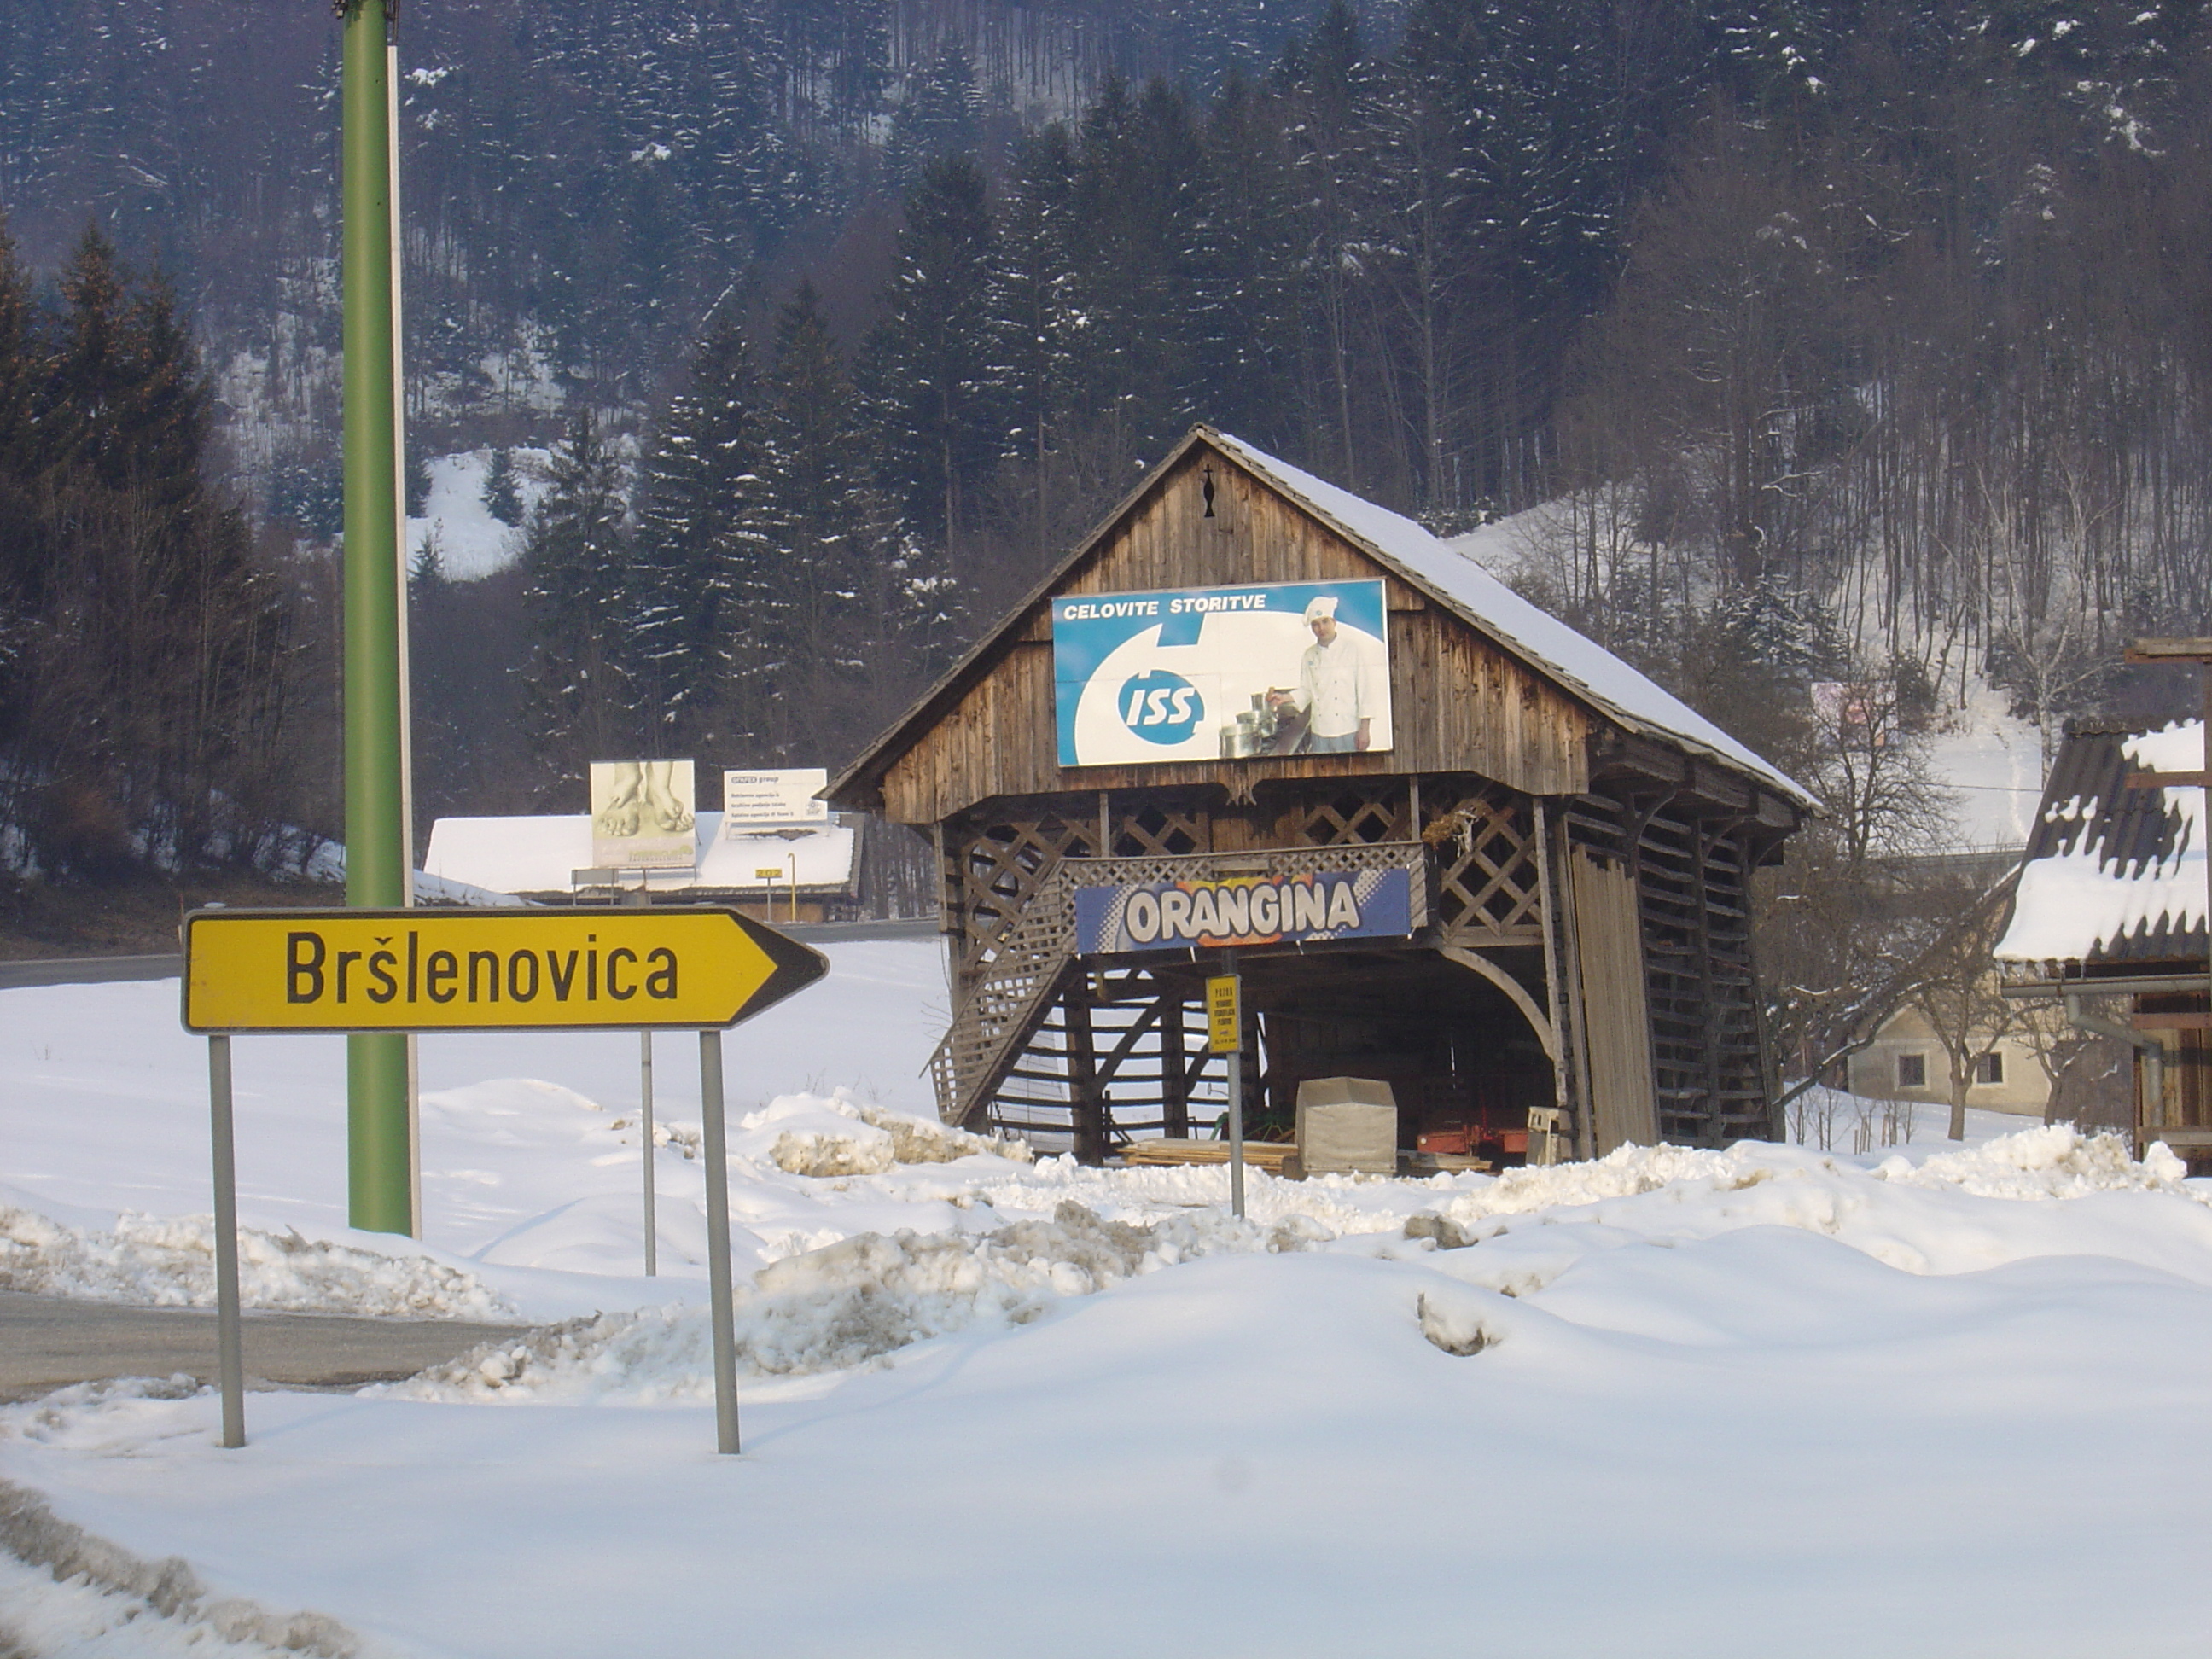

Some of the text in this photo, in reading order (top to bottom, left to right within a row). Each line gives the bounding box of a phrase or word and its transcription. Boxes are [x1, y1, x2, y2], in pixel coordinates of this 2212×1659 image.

[1063, 595, 1266, 620] CELOVITE STORITVE
[1125, 881, 1361, 943] ORANGINA
[287, 931, 678, 1004] Bršlenovica
